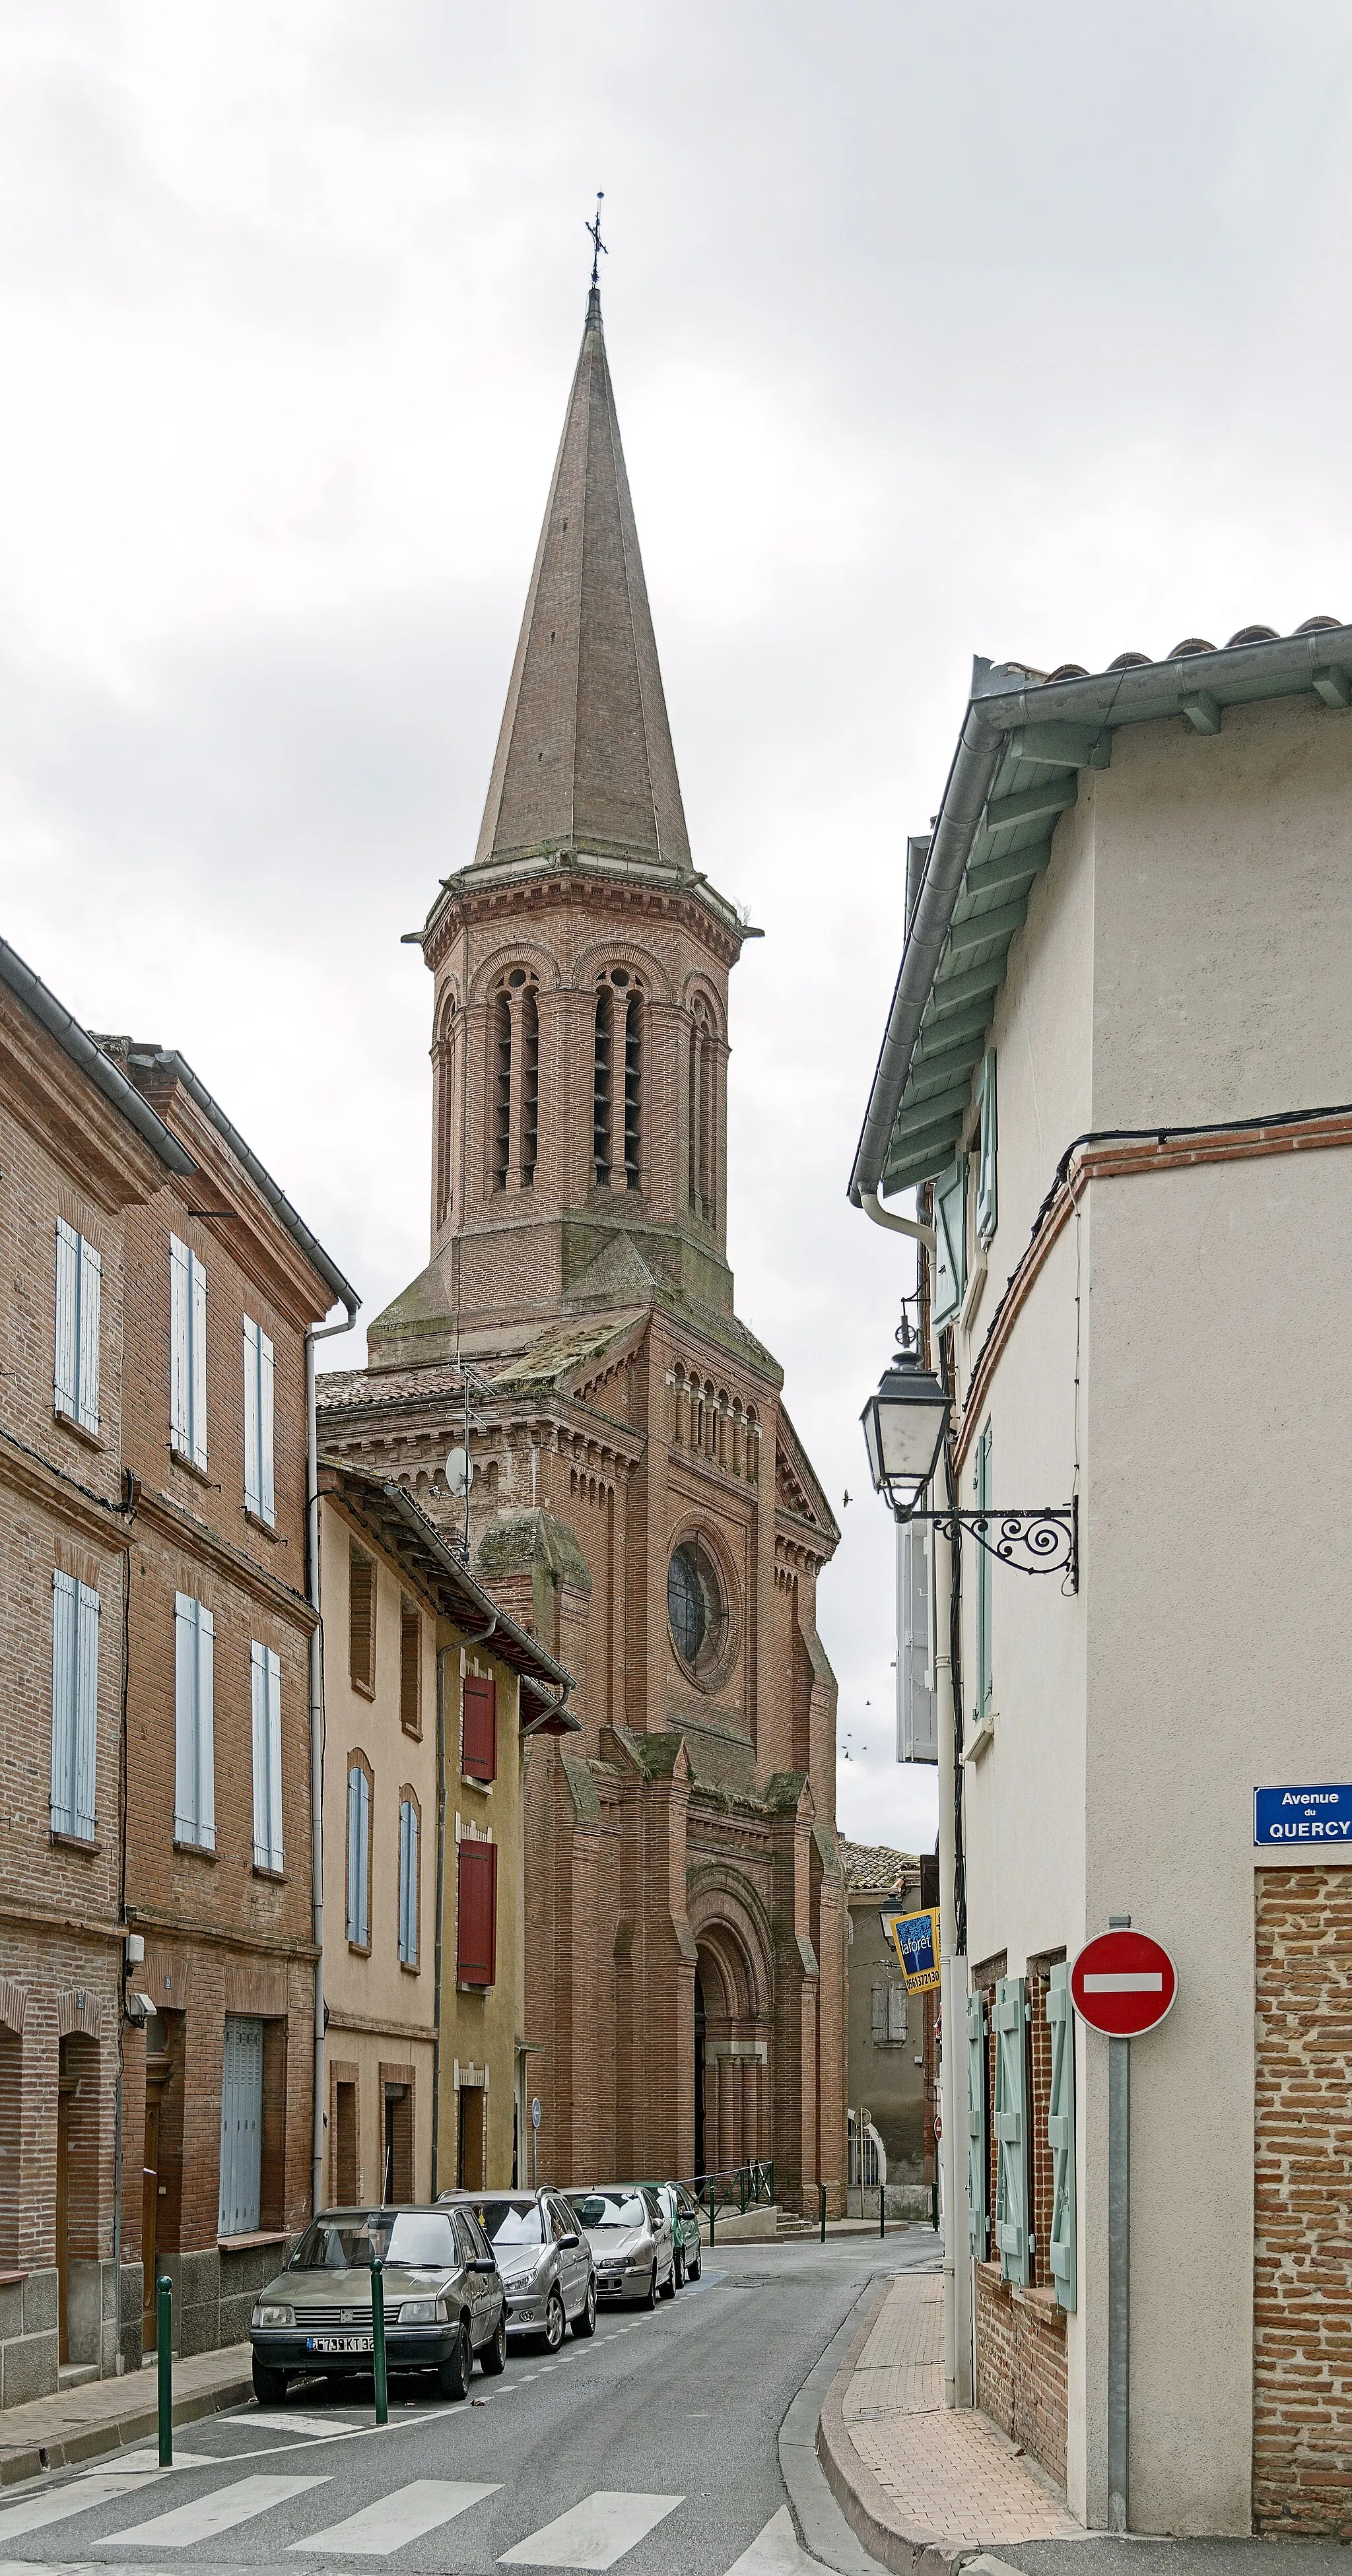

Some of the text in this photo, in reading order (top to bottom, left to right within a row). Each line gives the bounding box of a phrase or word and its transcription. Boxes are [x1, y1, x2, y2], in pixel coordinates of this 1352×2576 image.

[1281, 1793, 1339, 1805] Avenue
[1269, 1821, 1351, 1837] QUERCY
[900, 1934, 931, 1955] laforêt
[906, 1970, 939, 1990] 0561372130
[347, 2338, 359, 2350] KT
[362, 2338, 374, 2350] 32
